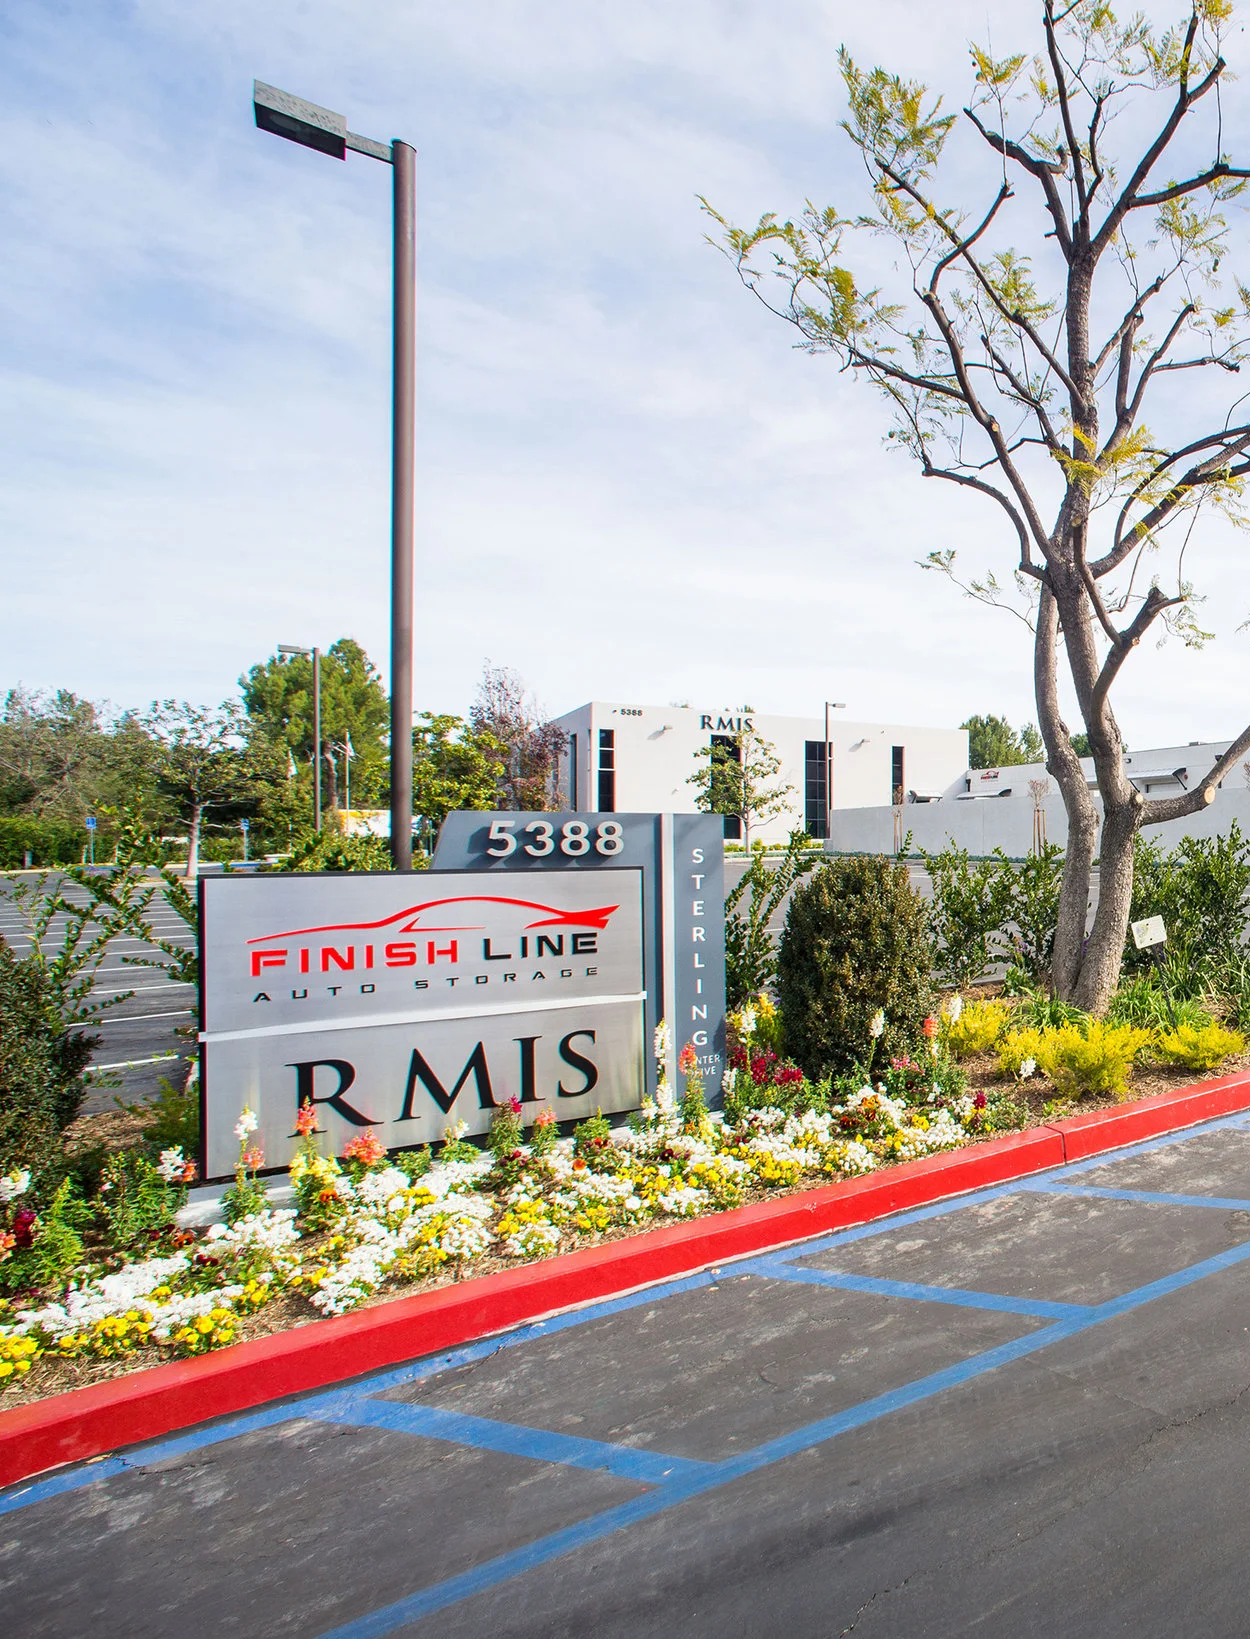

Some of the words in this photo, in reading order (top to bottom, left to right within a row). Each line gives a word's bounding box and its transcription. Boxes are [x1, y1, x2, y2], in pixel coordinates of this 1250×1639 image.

[620, 708, 643, 717] 5388
[700, 714, 753, 732] RMIS
[486, 820, 625, 857] 5388
[250, 940, 458, 977] FINISH
[482, 932, 599, 961] LINE
[690, 848, 709, 1046] STERLING
[253, 983, 376, 1002] AUTO
[415, 967, 599, 990] STORAGE
[690, 1054, 720, 1065] NTER
[284, 1029, 599, 1138] RMIS
